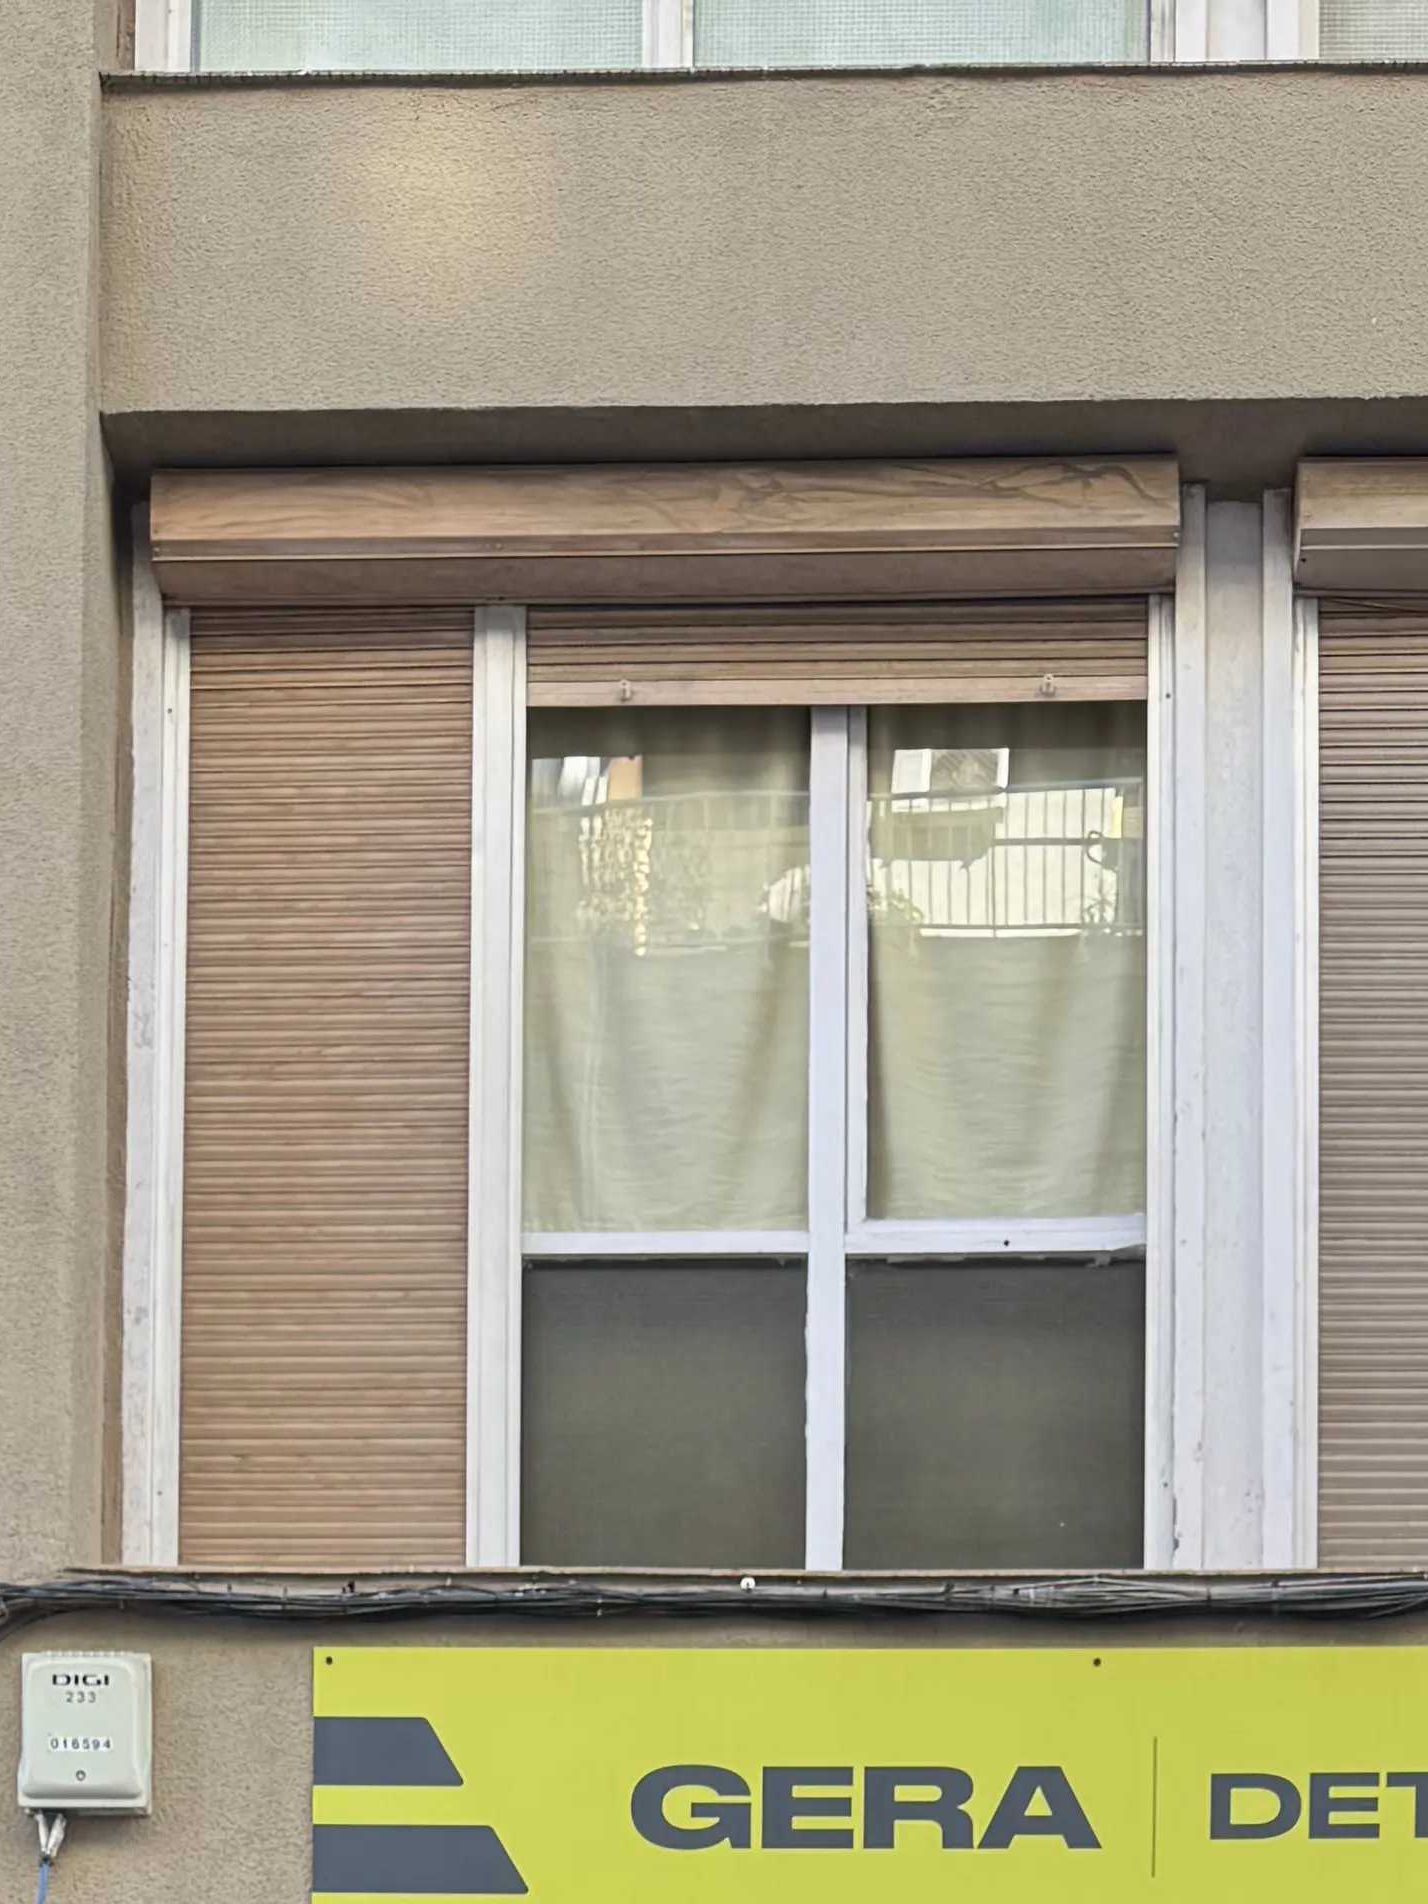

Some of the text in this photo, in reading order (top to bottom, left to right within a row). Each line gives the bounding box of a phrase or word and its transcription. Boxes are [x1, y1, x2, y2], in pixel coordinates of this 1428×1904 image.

[52, 1674, 110, 1686] DIGI
[65, 1691, 96, 1703] 233
[631, 1765, 1102, 1850] GERA
